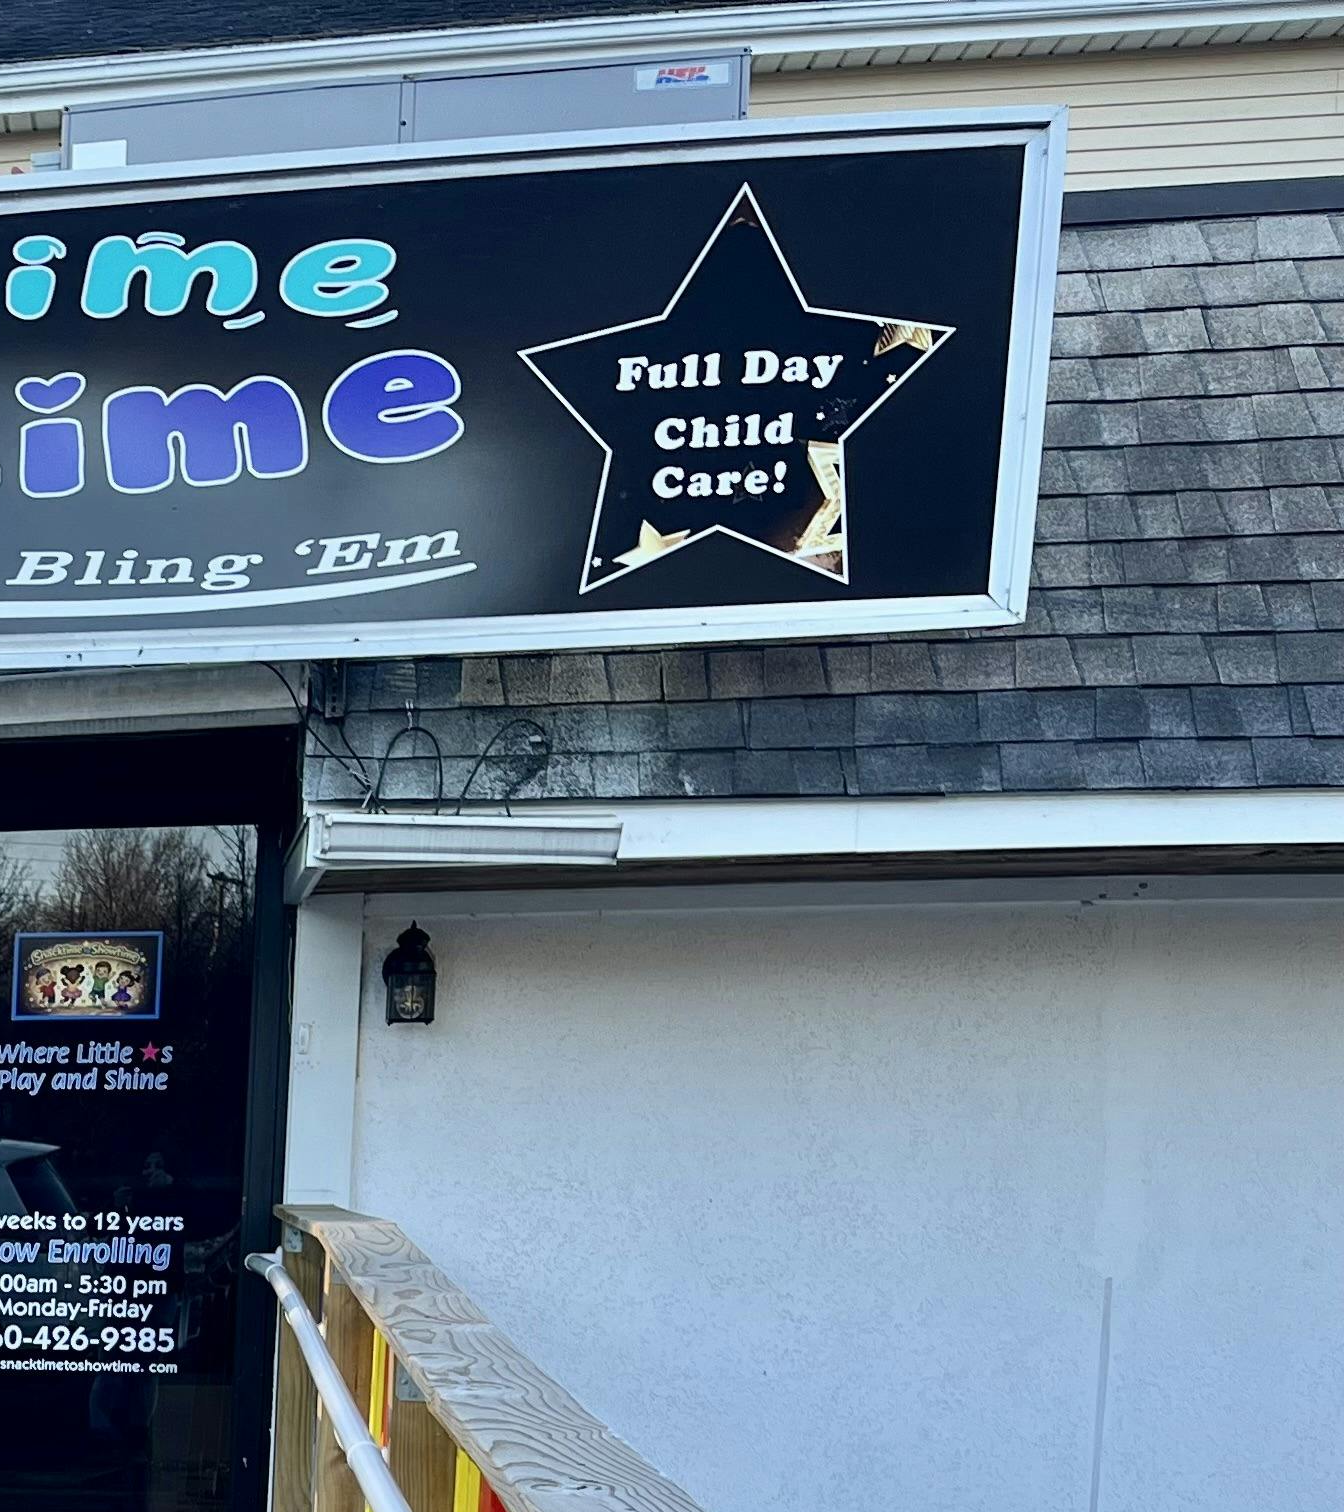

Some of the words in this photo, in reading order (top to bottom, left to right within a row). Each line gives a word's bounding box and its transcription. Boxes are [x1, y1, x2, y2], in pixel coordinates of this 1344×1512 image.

[616, 353, 721, 391] Full
[742, 350, 844, 389] Day
[654, 413, 794, 450] Child
[652, 461, 788, 499] Care!
[6, 550, 263, 590] Bling
[76, 1040, 134, 1064] Little
[51, 1067, 98, 1090] and
[103, 1066, 169, 1090] Shine
[63, 1212, 86, 1230] to
[93, 1212, 120, 1231] 12
[126, 1215, 184, 1234] years
[47, 1237, 172, 1271] Enrolling
[78, 1275, 127, 1294] 5:30
[132, 1278, 167, 1298] pm
